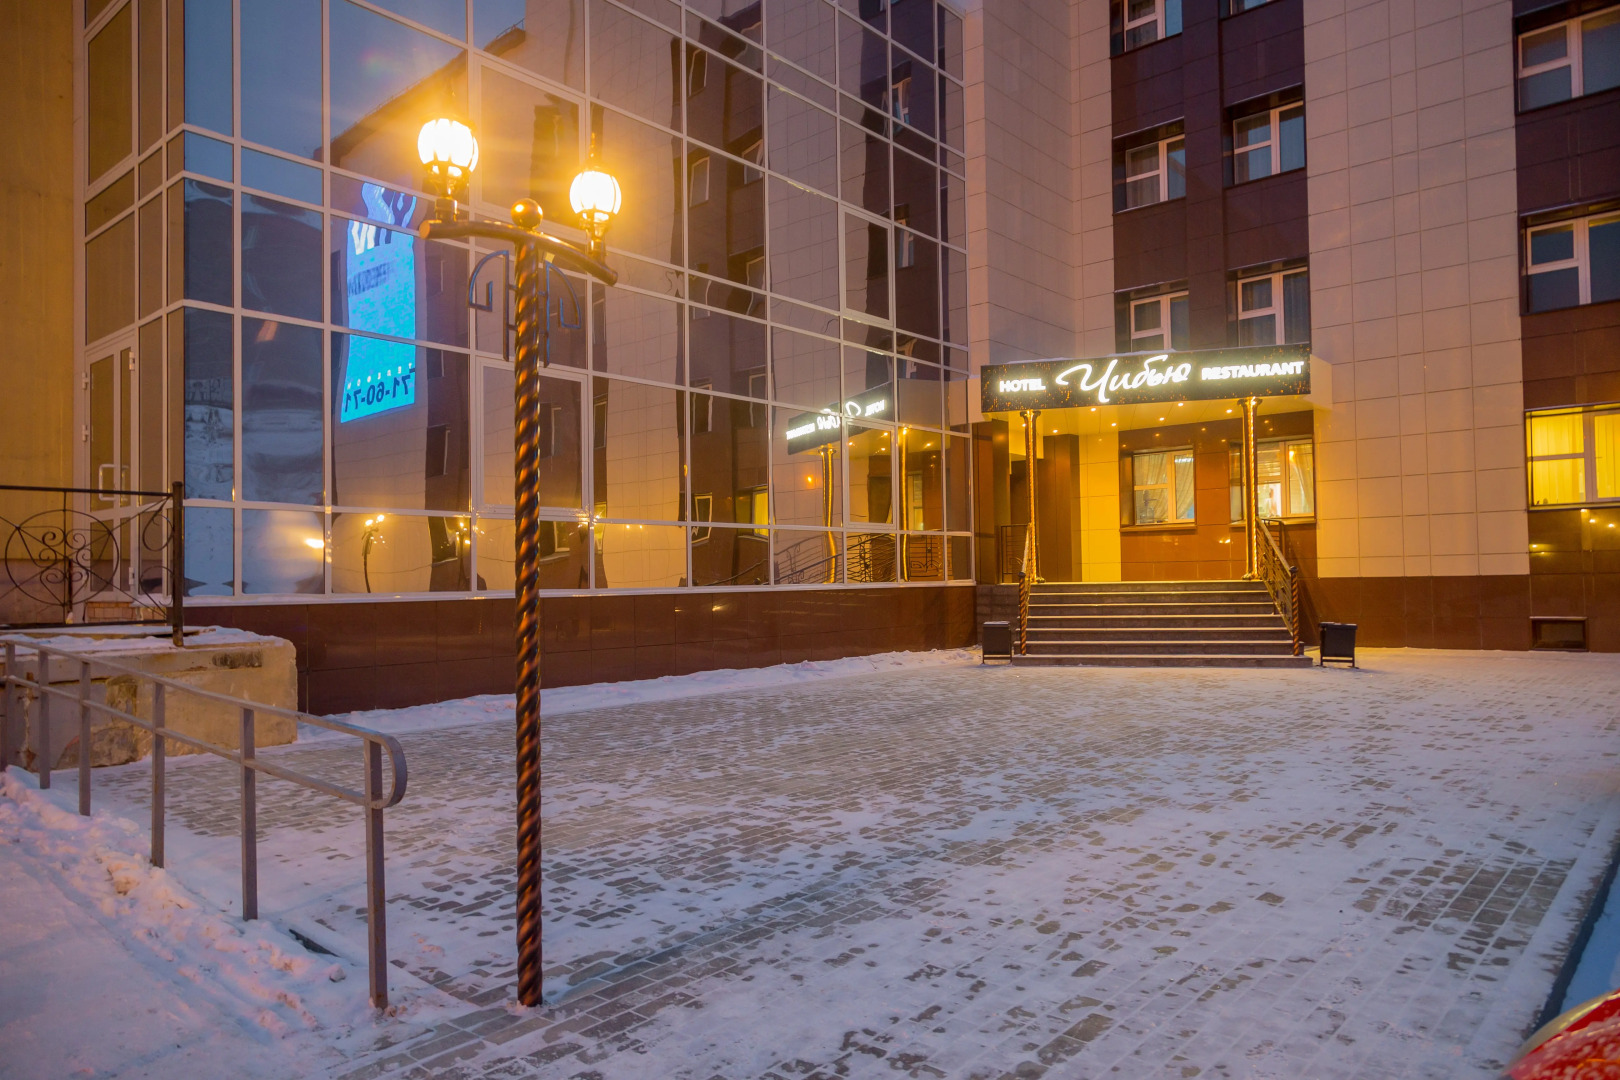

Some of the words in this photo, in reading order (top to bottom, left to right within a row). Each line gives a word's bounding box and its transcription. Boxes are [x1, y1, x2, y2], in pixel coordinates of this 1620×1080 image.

[999, 378, 1046, 393] HOTEL
[1055, 354, 1192, 403] Чибью
[1201, 360, 1304, 381] RESTAURANT
